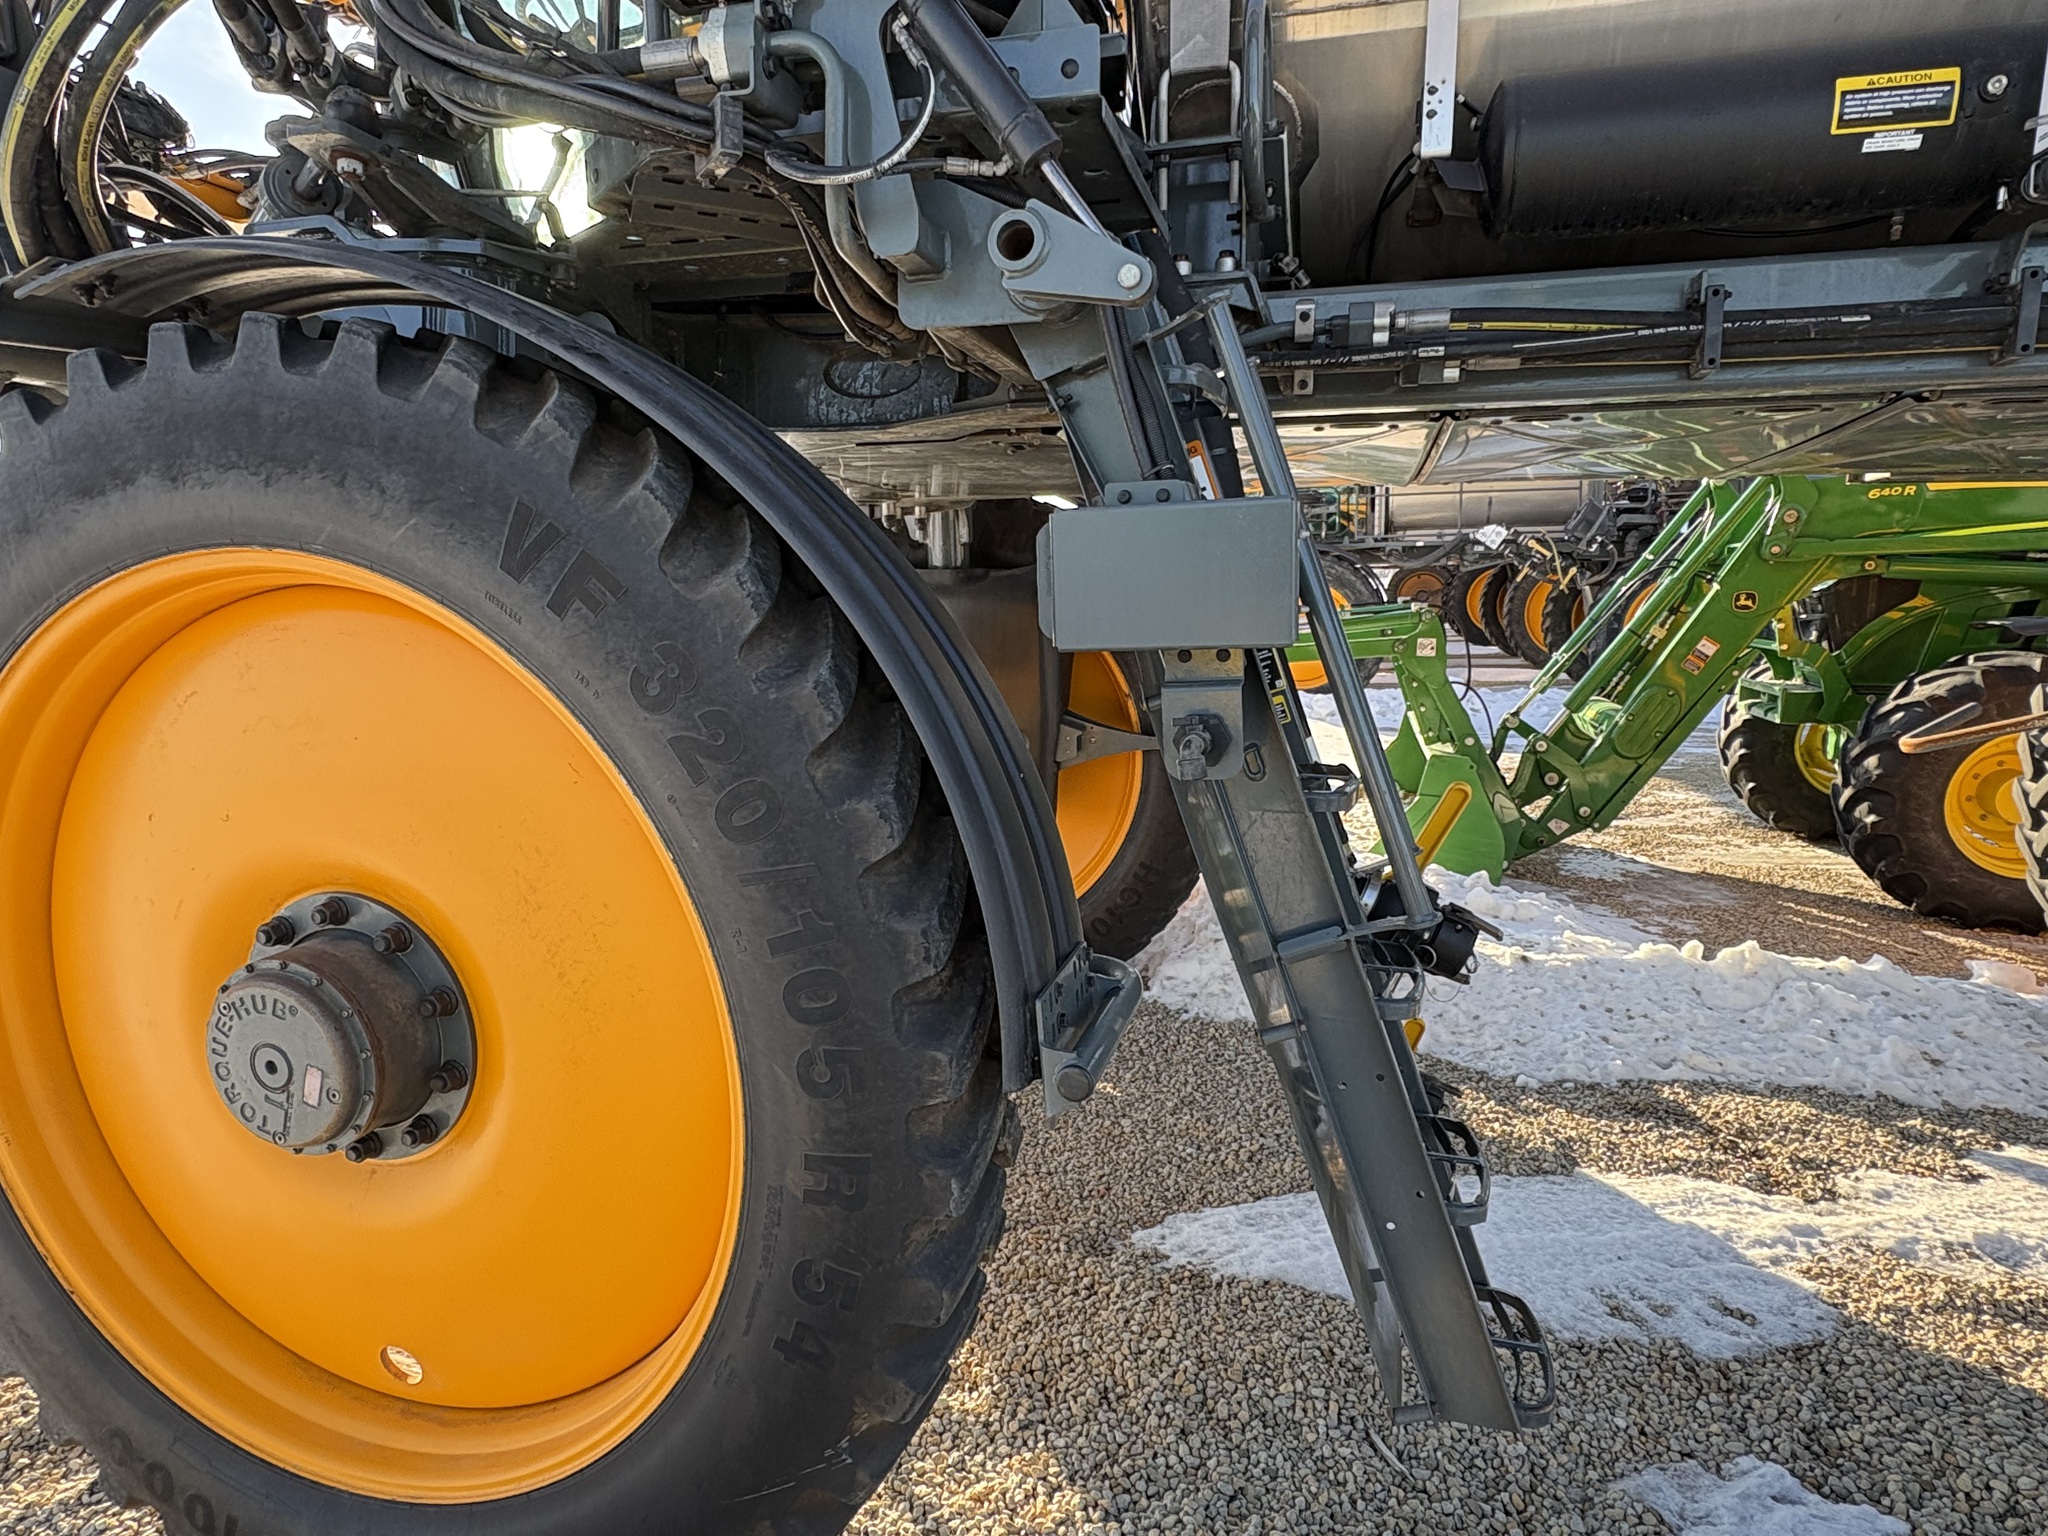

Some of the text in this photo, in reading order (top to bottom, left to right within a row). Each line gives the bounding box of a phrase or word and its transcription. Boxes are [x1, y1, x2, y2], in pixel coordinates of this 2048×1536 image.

[1876, 72, 1933, 85] CAUTION
[1369, 351, 1397, 360] SUCTION
[500, 498, 628, 621] VF
[484, 590, 523, 625] TUBELESS
